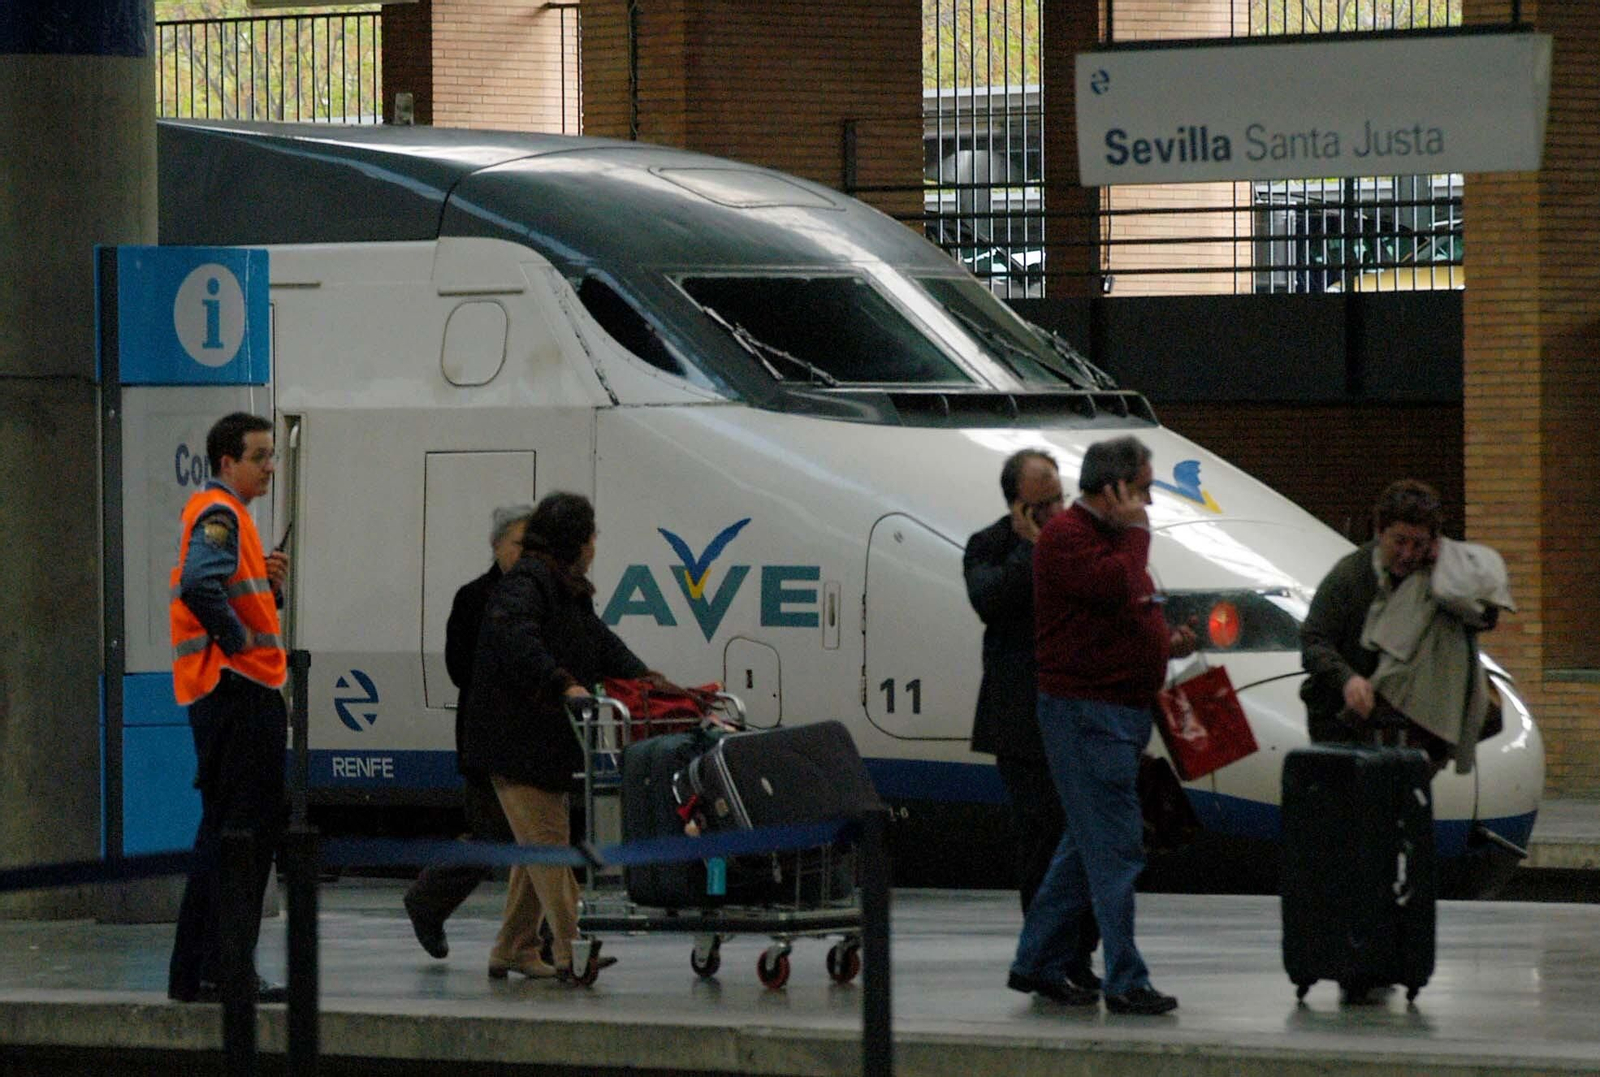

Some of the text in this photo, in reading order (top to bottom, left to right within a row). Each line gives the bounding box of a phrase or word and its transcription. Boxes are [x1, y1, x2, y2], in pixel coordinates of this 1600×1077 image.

[1105, 119, 1445, 165] Sevilla Santa Justa
[600, 565, 820, 643] AVE
[879, 678, 921, 714] 11
[332, 757, 394, 778] RENFE
